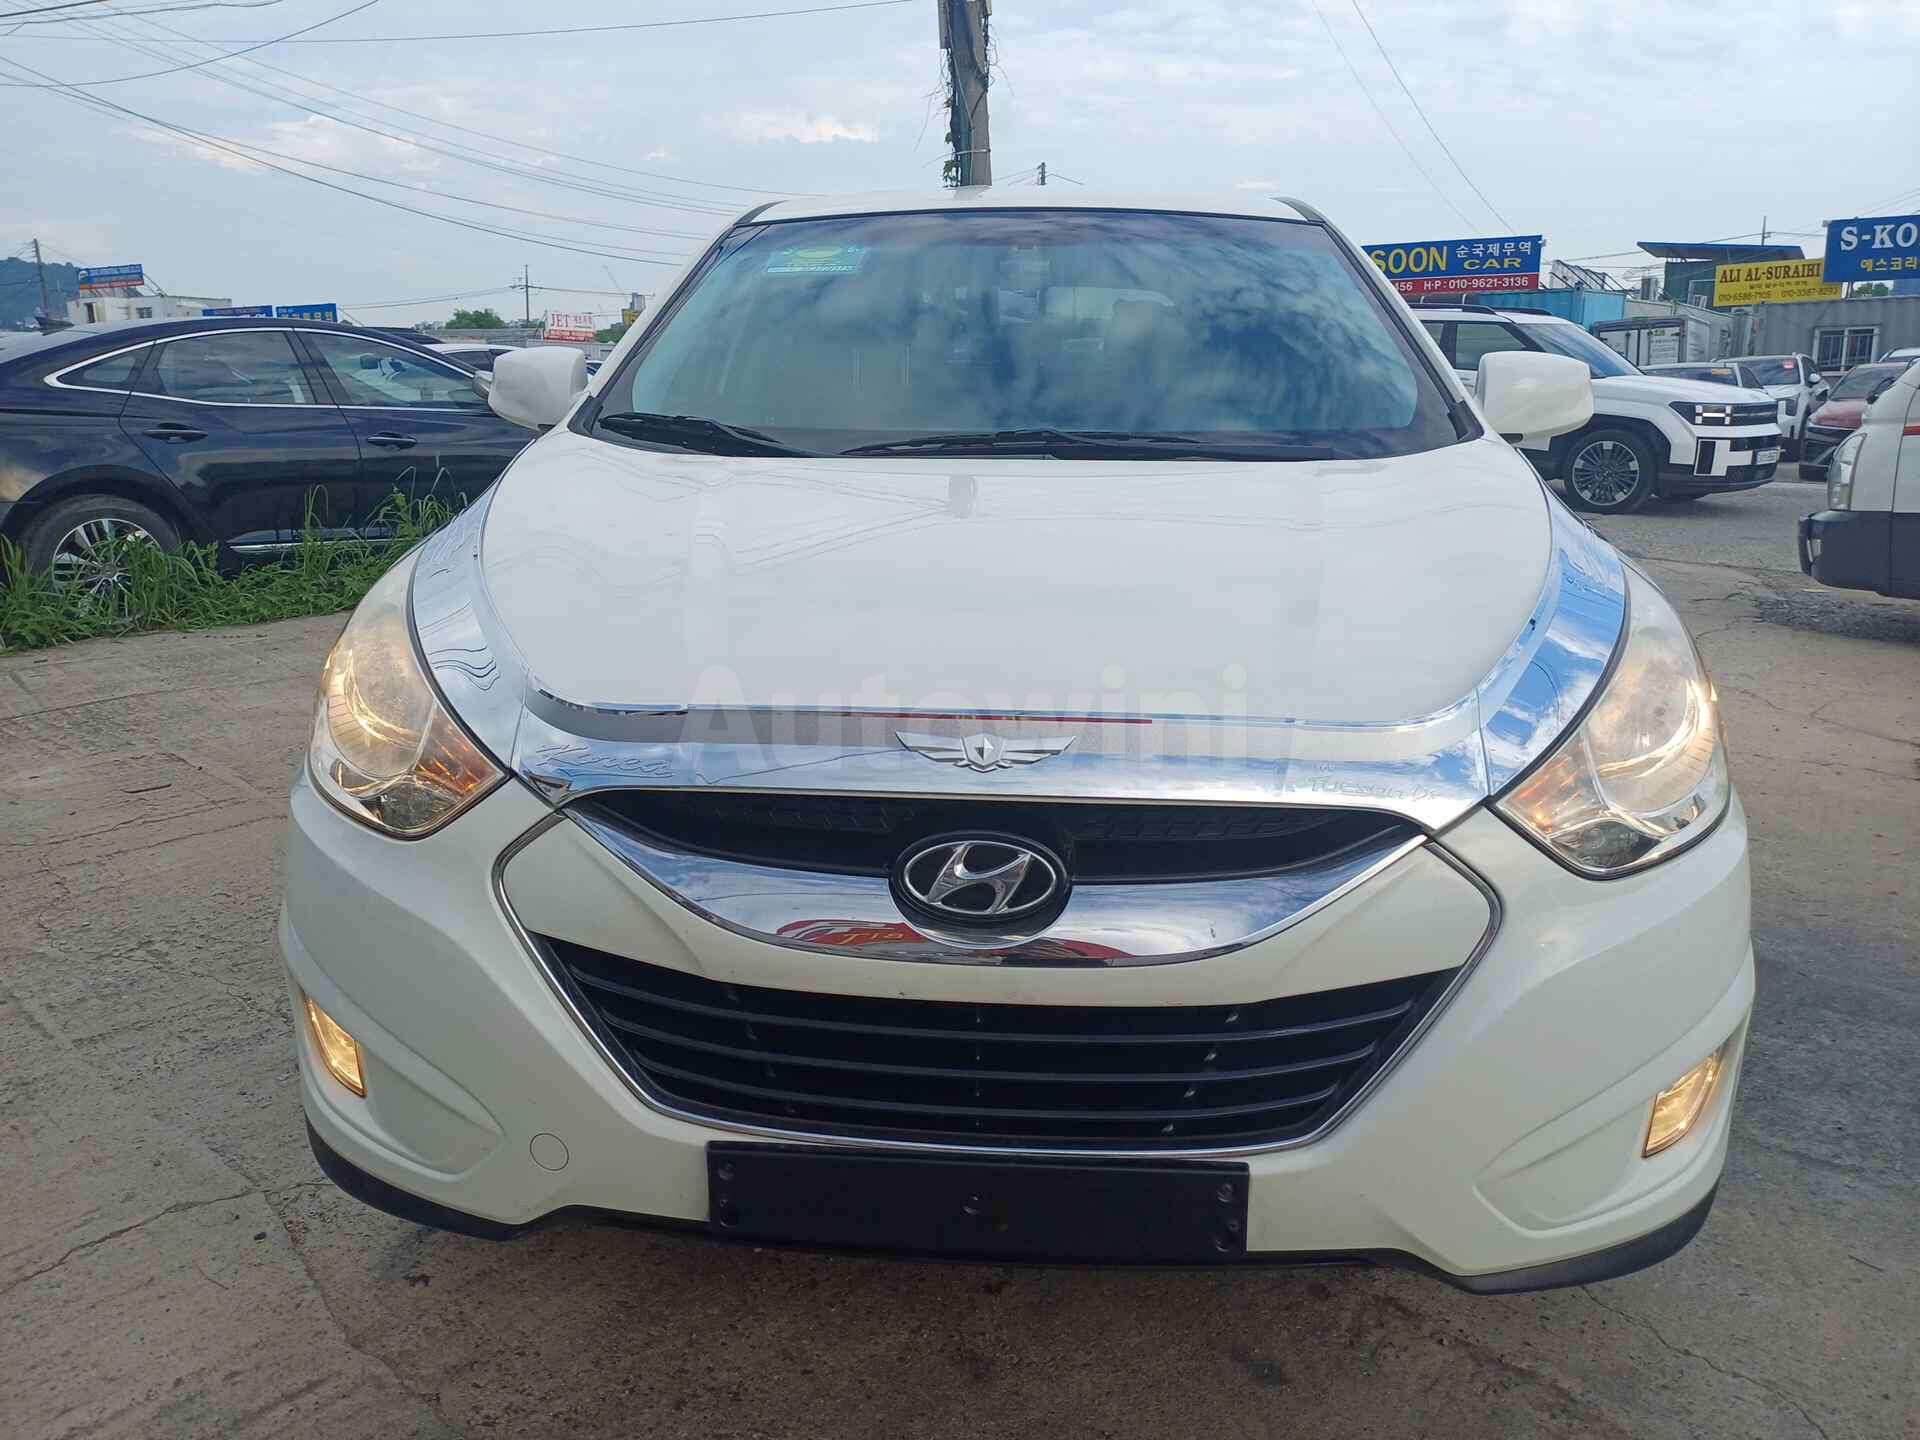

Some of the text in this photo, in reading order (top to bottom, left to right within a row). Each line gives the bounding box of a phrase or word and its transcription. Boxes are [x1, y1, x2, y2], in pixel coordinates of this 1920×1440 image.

[1840, 222, 1920, 251] S-KO
[1455, 241, 1532, 258] 순국제무역
[1369, 246, 1447, 273] SOON
[1463, 257, 1522, 270] CAR
[1720, 269, 1742, 283] ALI
